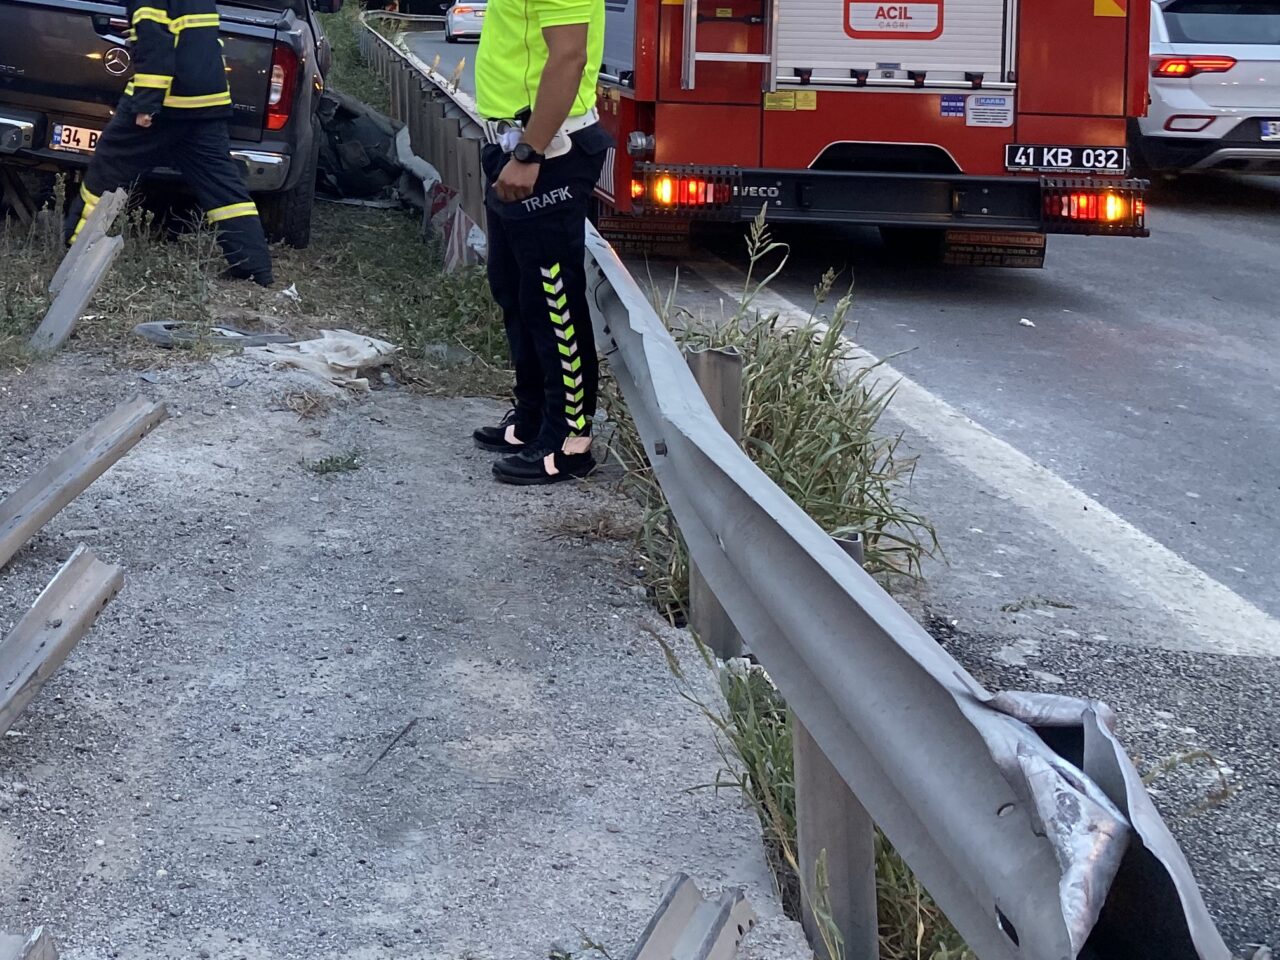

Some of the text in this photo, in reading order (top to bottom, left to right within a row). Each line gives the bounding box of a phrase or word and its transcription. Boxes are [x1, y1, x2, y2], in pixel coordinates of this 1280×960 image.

[61, 127, 81, 147] 34
[1014, 147, 1119, 169] 41 KB 032
[732, 185, 780, 198] IVECO
